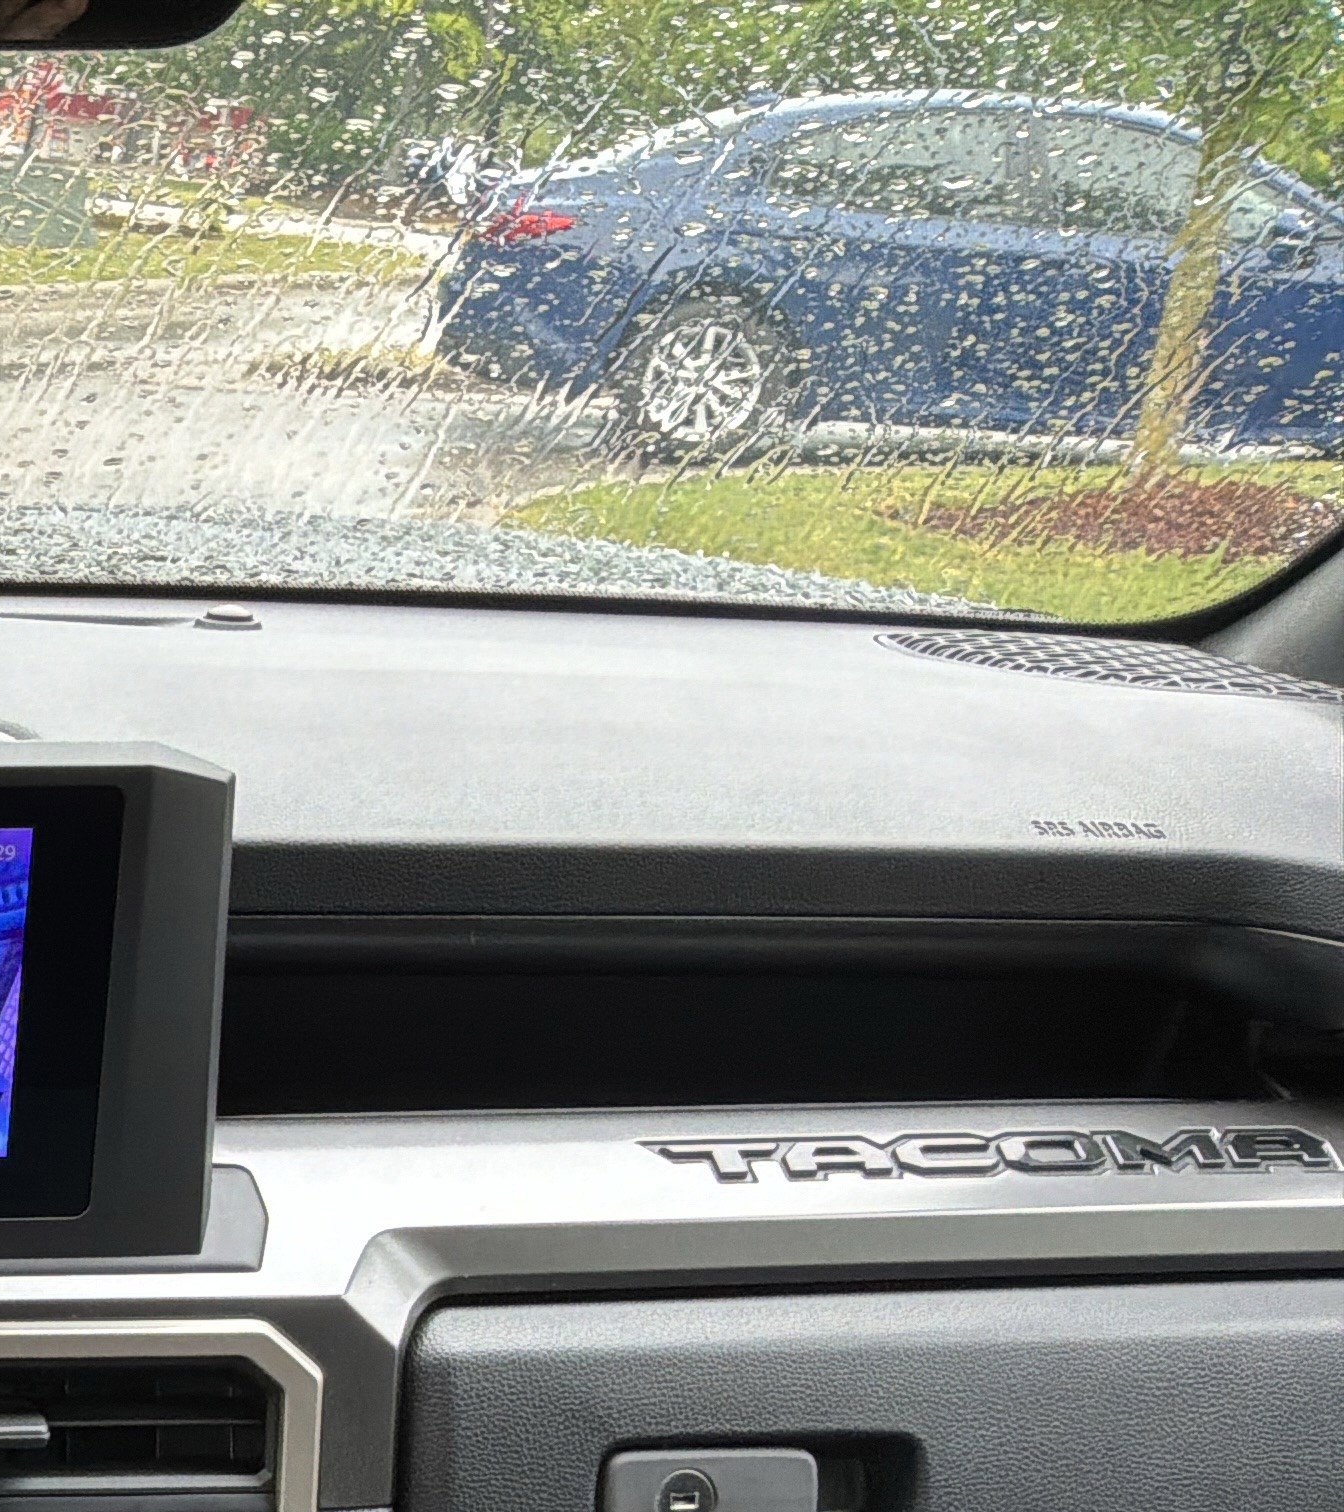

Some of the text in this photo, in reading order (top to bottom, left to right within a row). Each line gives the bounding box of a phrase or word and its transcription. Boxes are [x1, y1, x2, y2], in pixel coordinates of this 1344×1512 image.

[1031, 820, 1167, 839] SRS AIRBAG
[635, 1127, 1343, 1184] TACOMA
